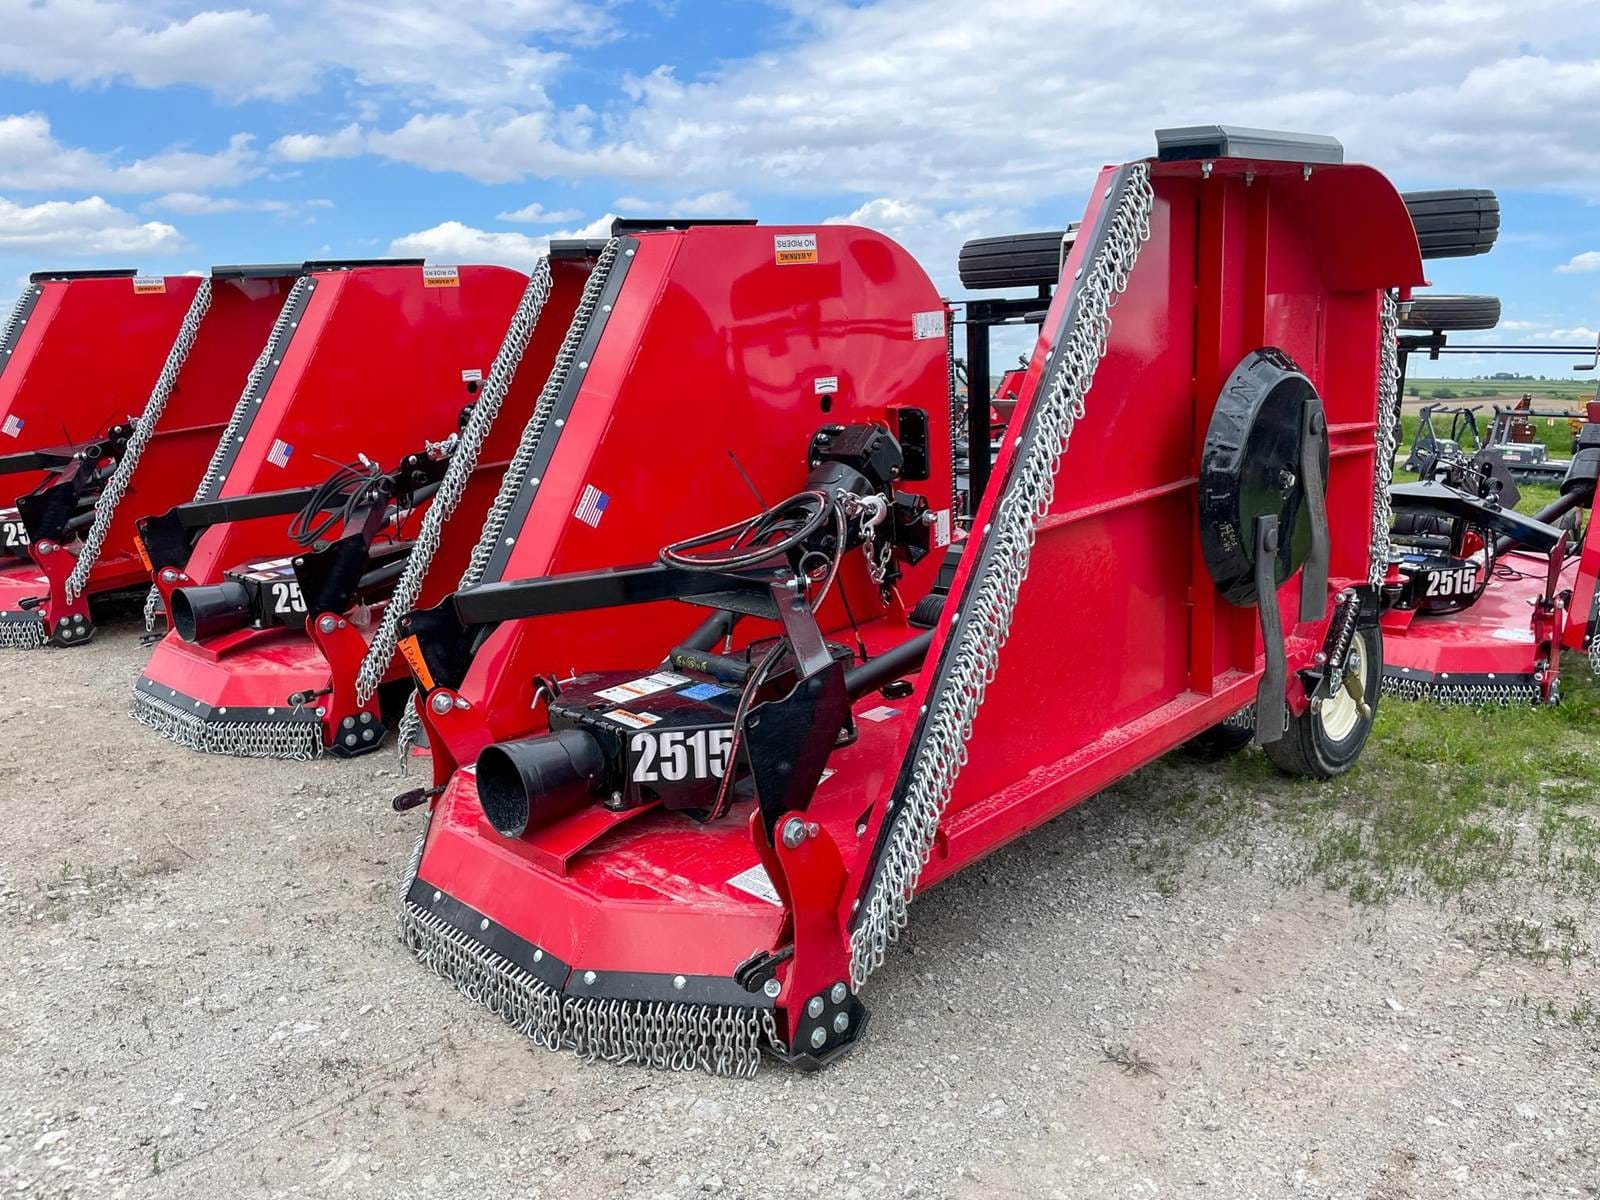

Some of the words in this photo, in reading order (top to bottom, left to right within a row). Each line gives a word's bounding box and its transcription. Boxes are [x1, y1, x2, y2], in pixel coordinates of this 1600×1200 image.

[776, 240, 803, 248] RIDERS
[1426, 568, 1477, 597] 2515
[630, 729, 735, 783] 2515
